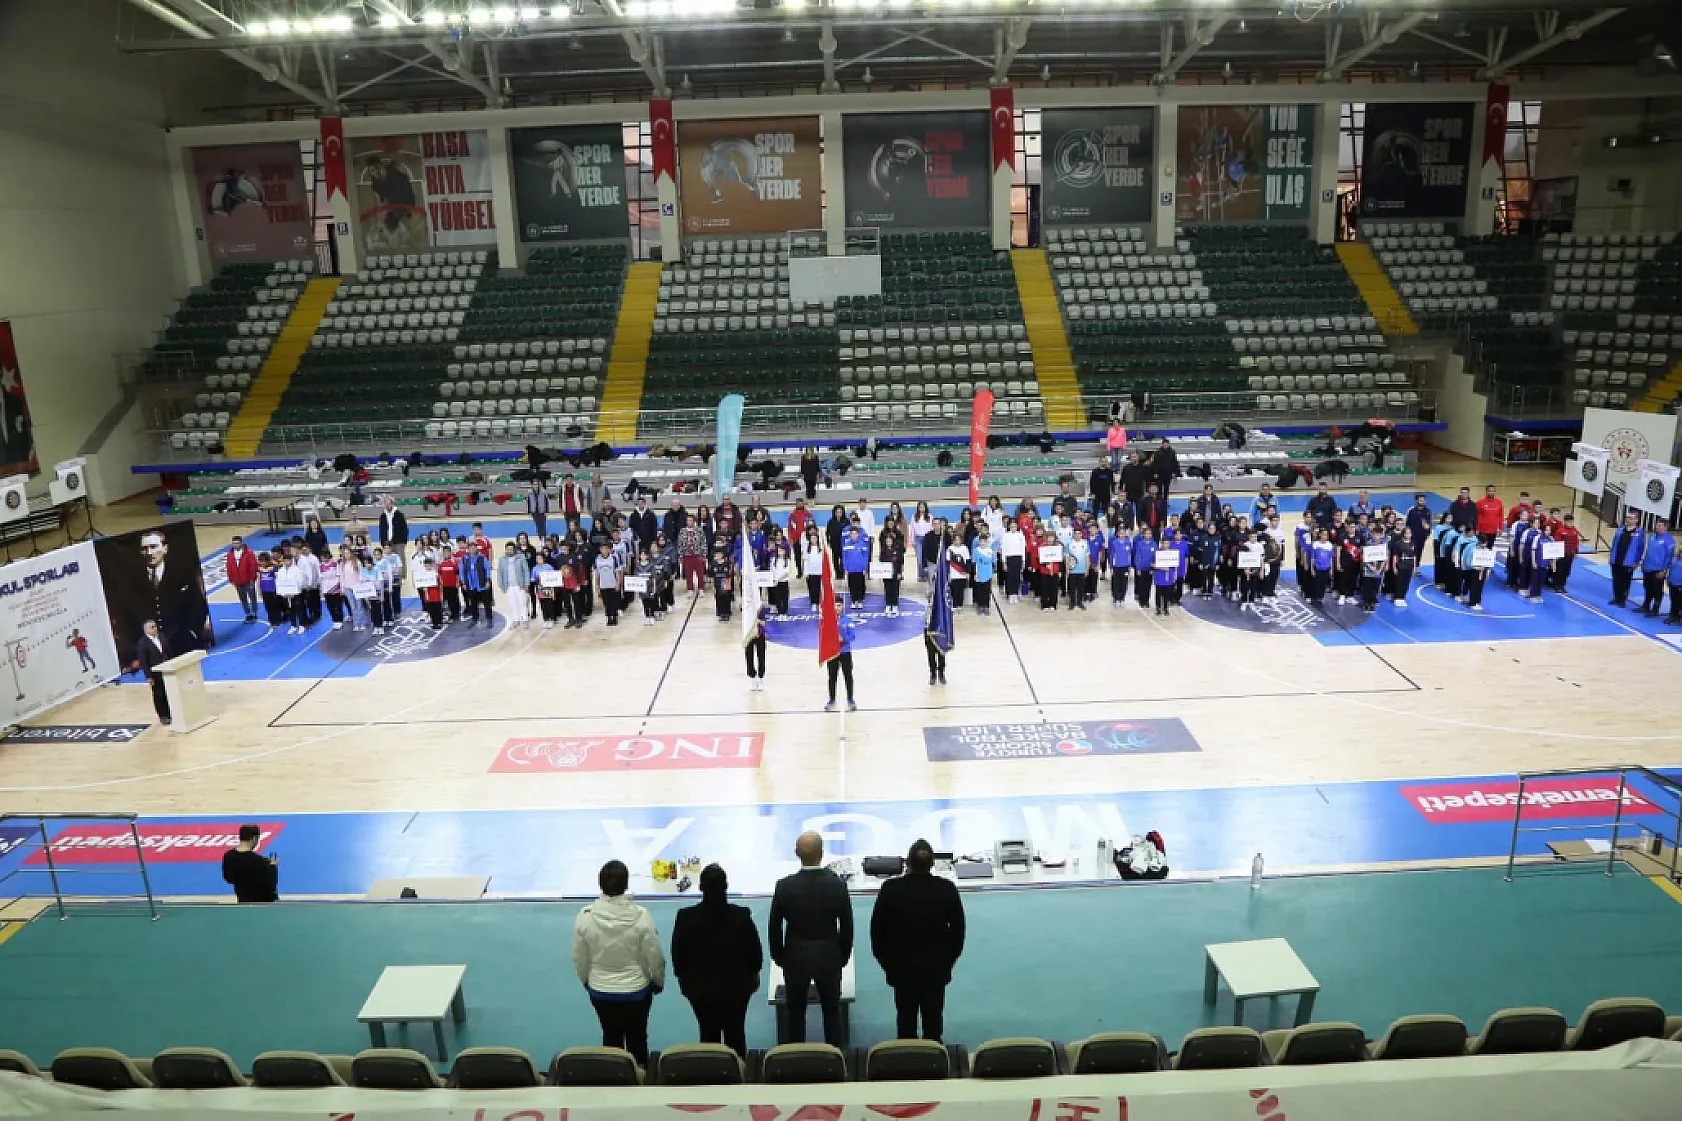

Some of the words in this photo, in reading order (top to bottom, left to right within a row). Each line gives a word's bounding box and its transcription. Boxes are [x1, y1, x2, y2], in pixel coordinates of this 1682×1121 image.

[1103, 125, 1140, 144] SPOR
[1424, 118, 1464, 139] SPOR
[755, 132, 796, 154] SPOR
[1422, 141, 1450, 162] HER
[573, 144, 612, 165] SPOR
[1103, 146, 1129, 166] HER
[576, 166, 602, 185] HER
[757, 156, 784, 177] HER
[1103, 167, 1144, 187] YERDE
[1421, 164, 1464, 186] YERDE
[578, 186, 621, 206] YERDE
[757, 178, 801, 200] YERDE
[1265, 174, 1305, 208] ULAŞ
[428, 198, 495, 231] YÜKSEL
[614, 736, 758, 761] ING
